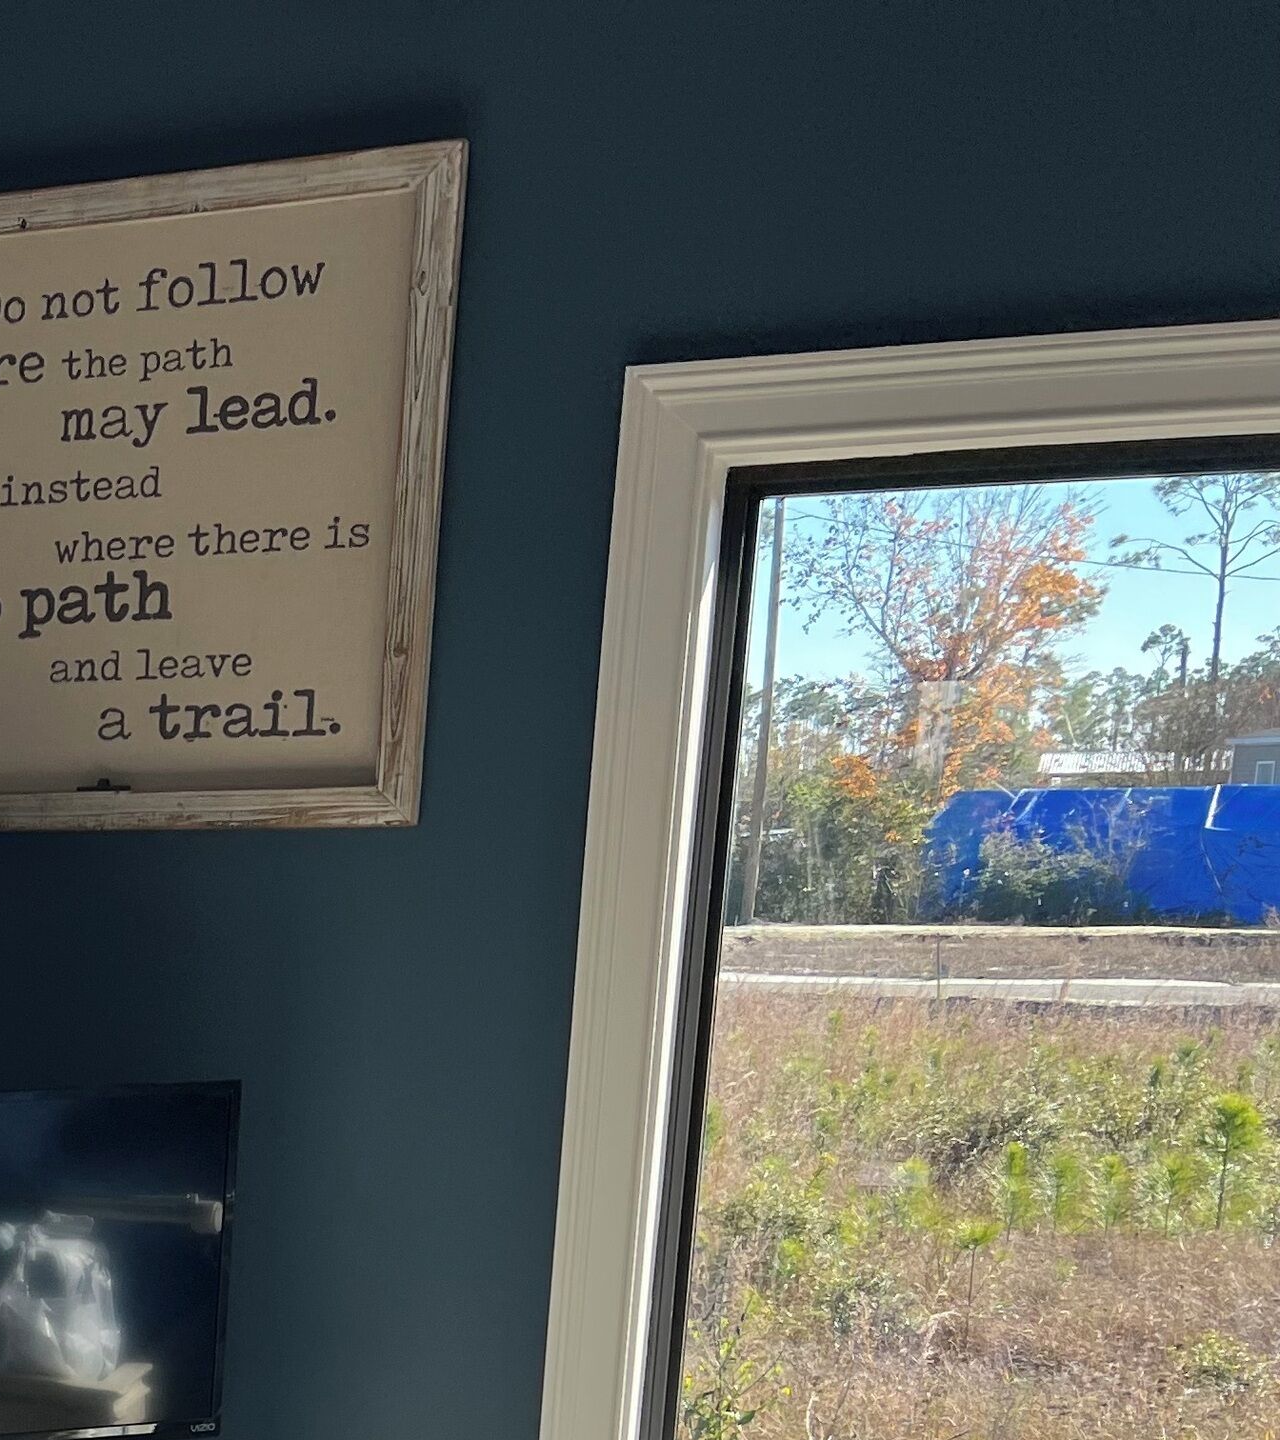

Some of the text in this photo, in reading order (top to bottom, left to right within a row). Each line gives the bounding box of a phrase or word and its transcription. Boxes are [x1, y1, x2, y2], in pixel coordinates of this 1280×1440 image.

[41, 278, 120, 321] not
[136, 259, 326, 312] follow
[62, 349, 127, 380] the
[139, 338, 234, 383] path
[60, 378, 337, 448] may lead.
[0, 466, 163, 508] instead
[54, 516, 371, 564] where there is
[18, 570, 173, 639] path
[50, 649, 252, 684] and leave
[98, 689, 341, 743] a trail.
